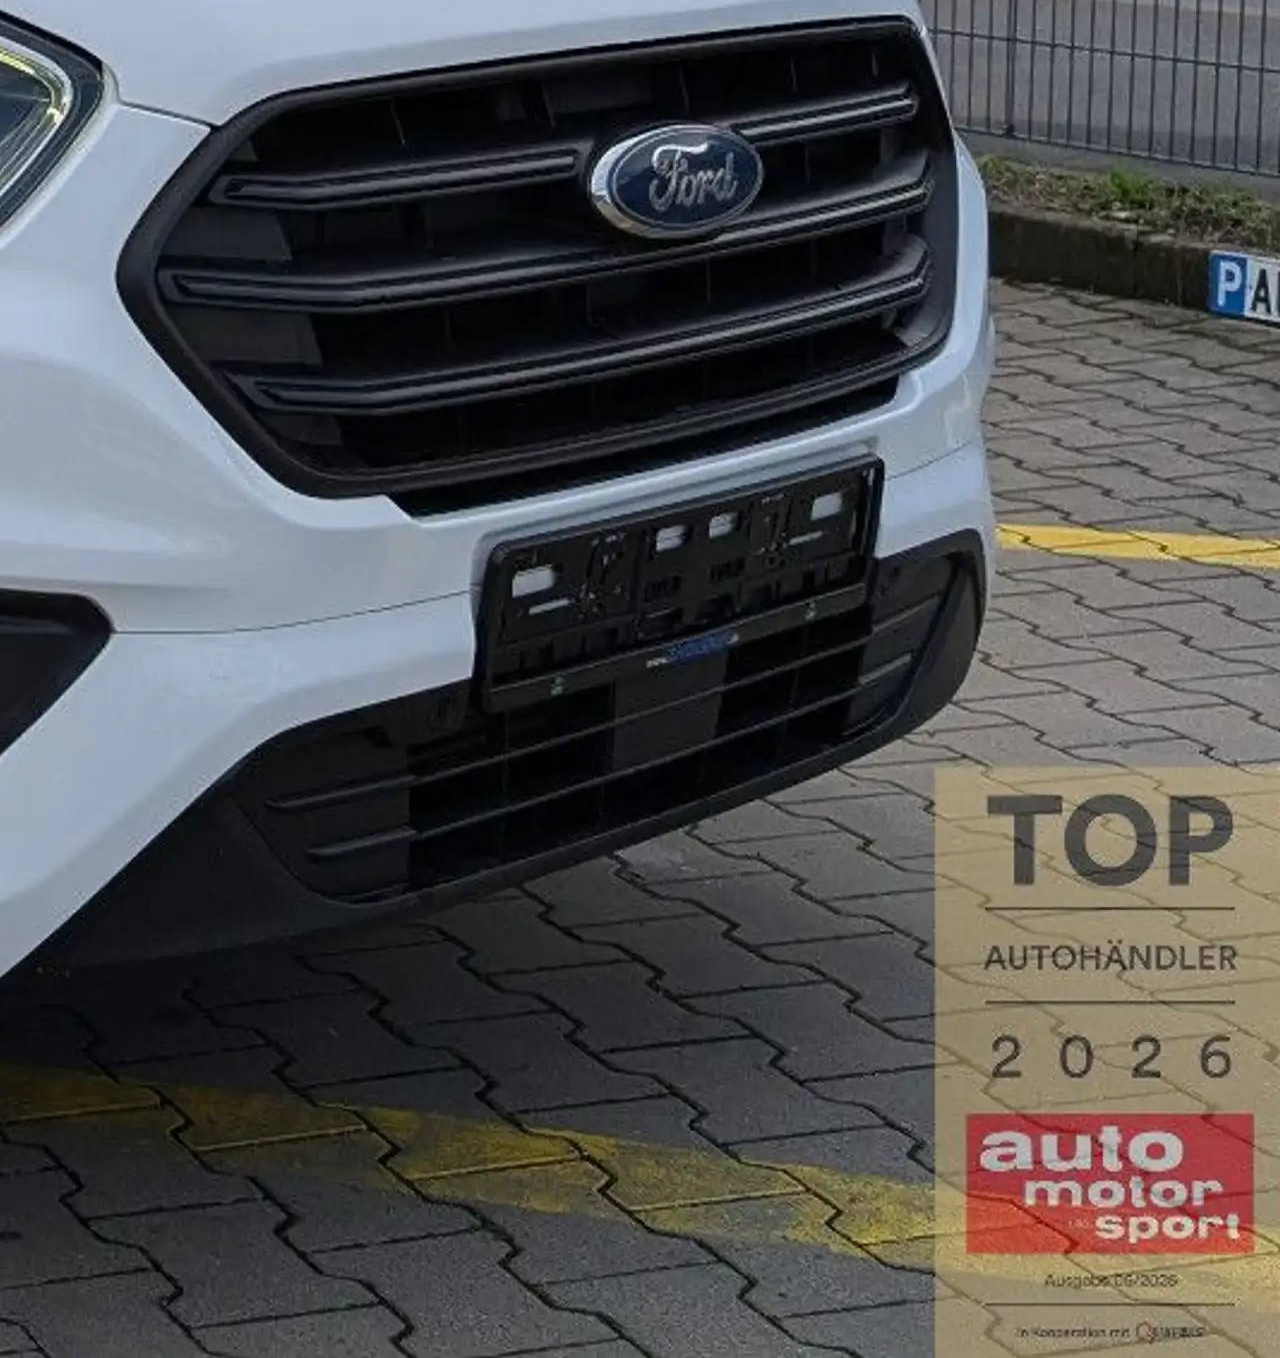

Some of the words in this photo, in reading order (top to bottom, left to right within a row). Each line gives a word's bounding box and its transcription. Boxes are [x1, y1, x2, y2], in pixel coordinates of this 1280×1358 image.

[648, 141, 739, 213] Ford
[1217, 259, 1243, 307] P
[1251, 268, 1280, 318] A
